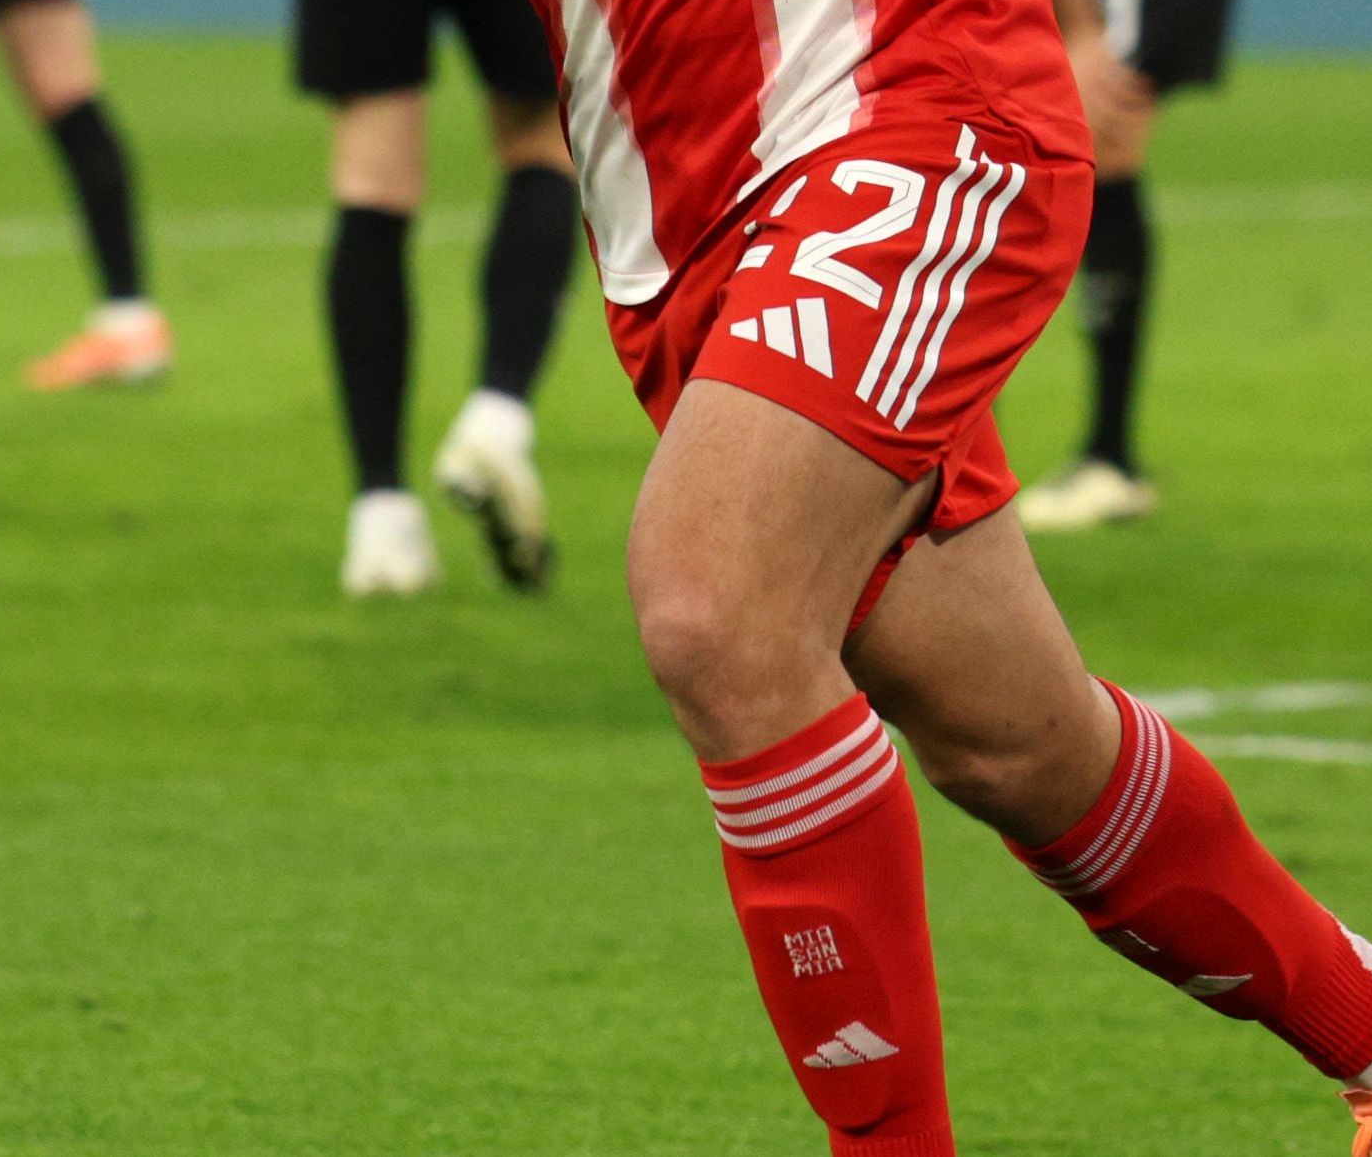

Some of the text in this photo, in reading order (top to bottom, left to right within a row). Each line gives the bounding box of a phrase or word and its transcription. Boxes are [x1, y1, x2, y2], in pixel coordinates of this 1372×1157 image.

[784, 926, 833, 949] MIA
[789, 939, 838, 964] SAN
[793, 956, 843, 977] MIA
